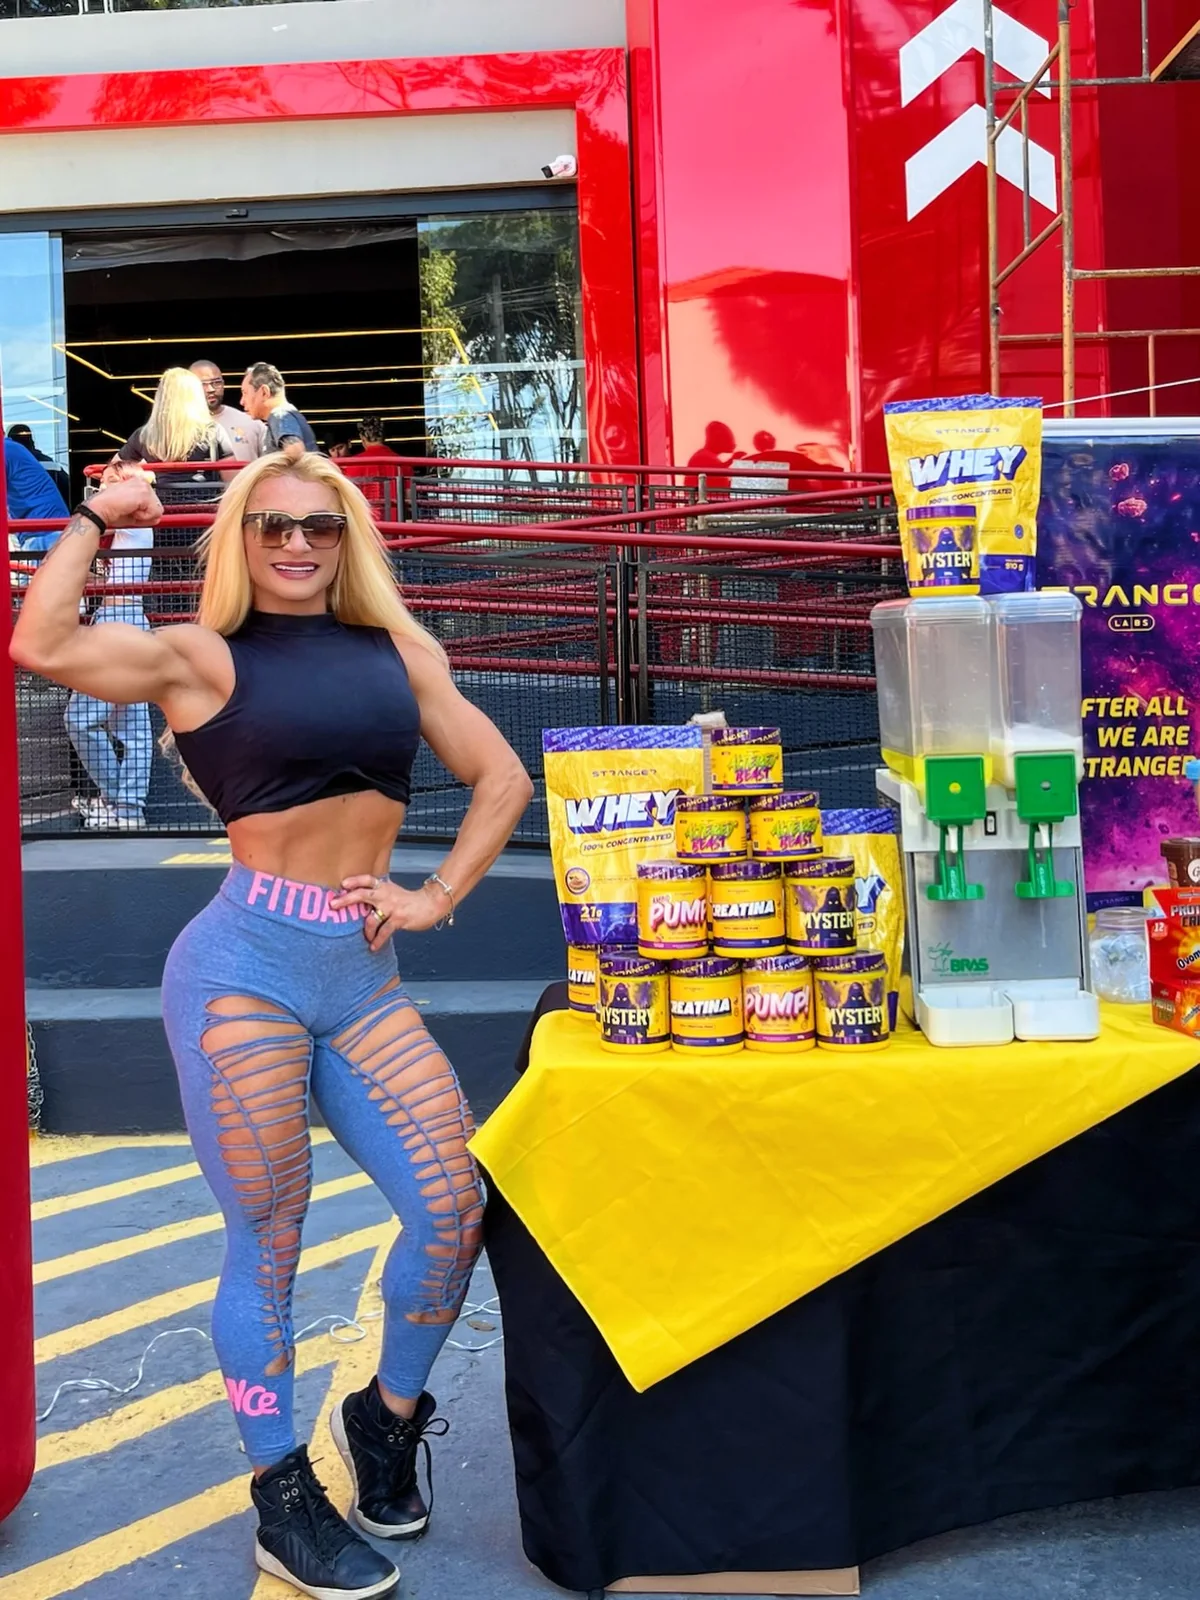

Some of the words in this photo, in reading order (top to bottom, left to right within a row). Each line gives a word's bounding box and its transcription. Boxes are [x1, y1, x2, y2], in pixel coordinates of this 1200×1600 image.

[908, 445, 1027, 492] WHEY
[1114, 619, 1149, 627] LABS
[1080, 696, 1139, 718] FTER
[1144, 696, 1189, 716] ALL
[1097, 726, 1137, 748] WE
[1141, 725, 1190, 746] ARE
[565, 789, 685, 834] WHEY
[606, 832, 672, 849] CONCENTRATED
[247, 871, 369, 924] FITDAN
[804, 911, 854, 929] MYSTER
[1154, 922, 1164, 932] 12
[671, 997, 731, 1017] REATINA
